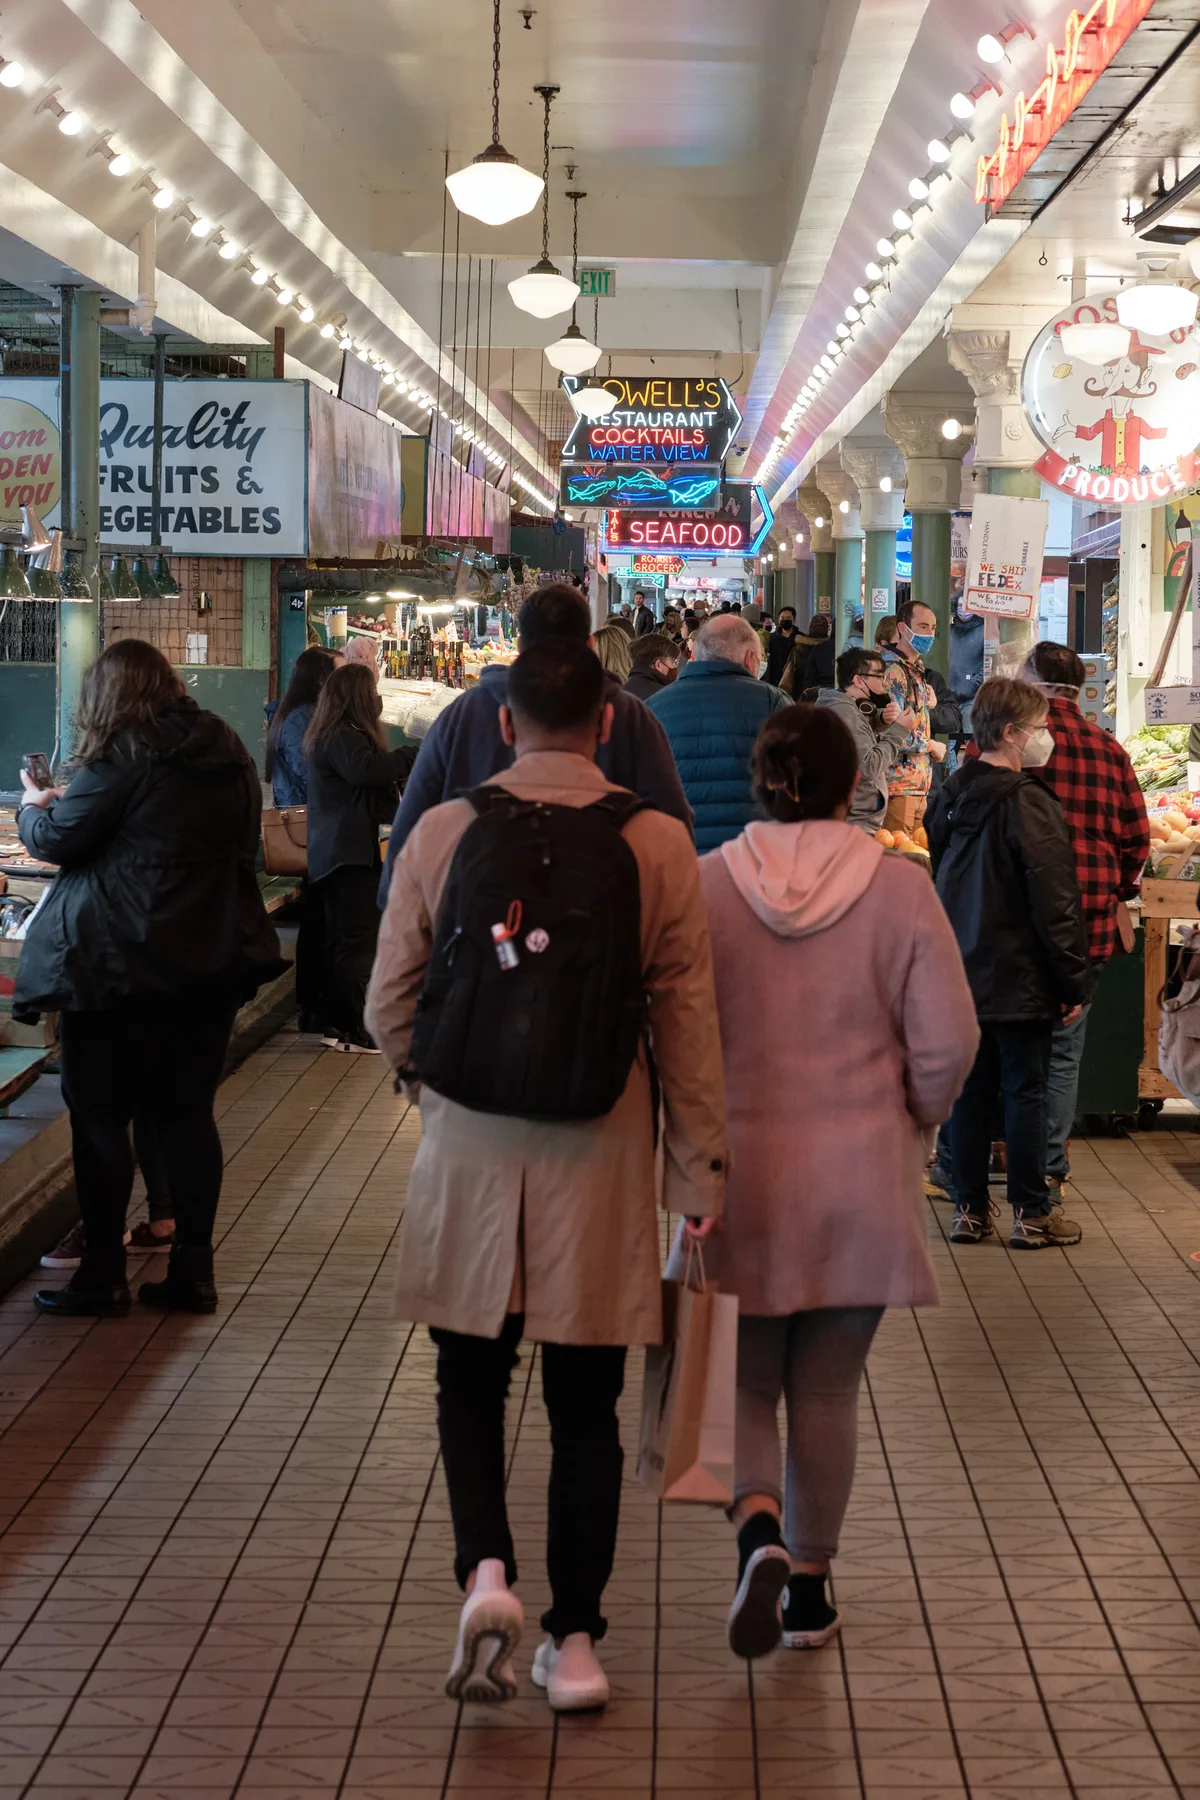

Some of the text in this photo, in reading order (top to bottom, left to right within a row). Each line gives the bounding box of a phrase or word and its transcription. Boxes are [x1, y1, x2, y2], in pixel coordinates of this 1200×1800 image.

[581, 271, 610, 295] EXIT
[588, 378, 721, 409] OWELL'S
[99, 400, 266, 463] Quality
[587, 411, 718, 428] RESTAURANT
[591, 428, 706, 445] COCKTAILS
[588, 444, 709, 461] WATER VIEW
[99, 465, 220, 494] FRUITS
[236, 466, 264, 496] &
[1057, 464, 1187, 502] PRODUCE
[4, 482, 55, 507] YOU
[99, 505, 282, 535] EGETABLES
[630, 521, 742, 547] SEAFOOD
[634, 563, 681, 573] GROCERY
[980, 562, 1027, 576] WE SHIP
